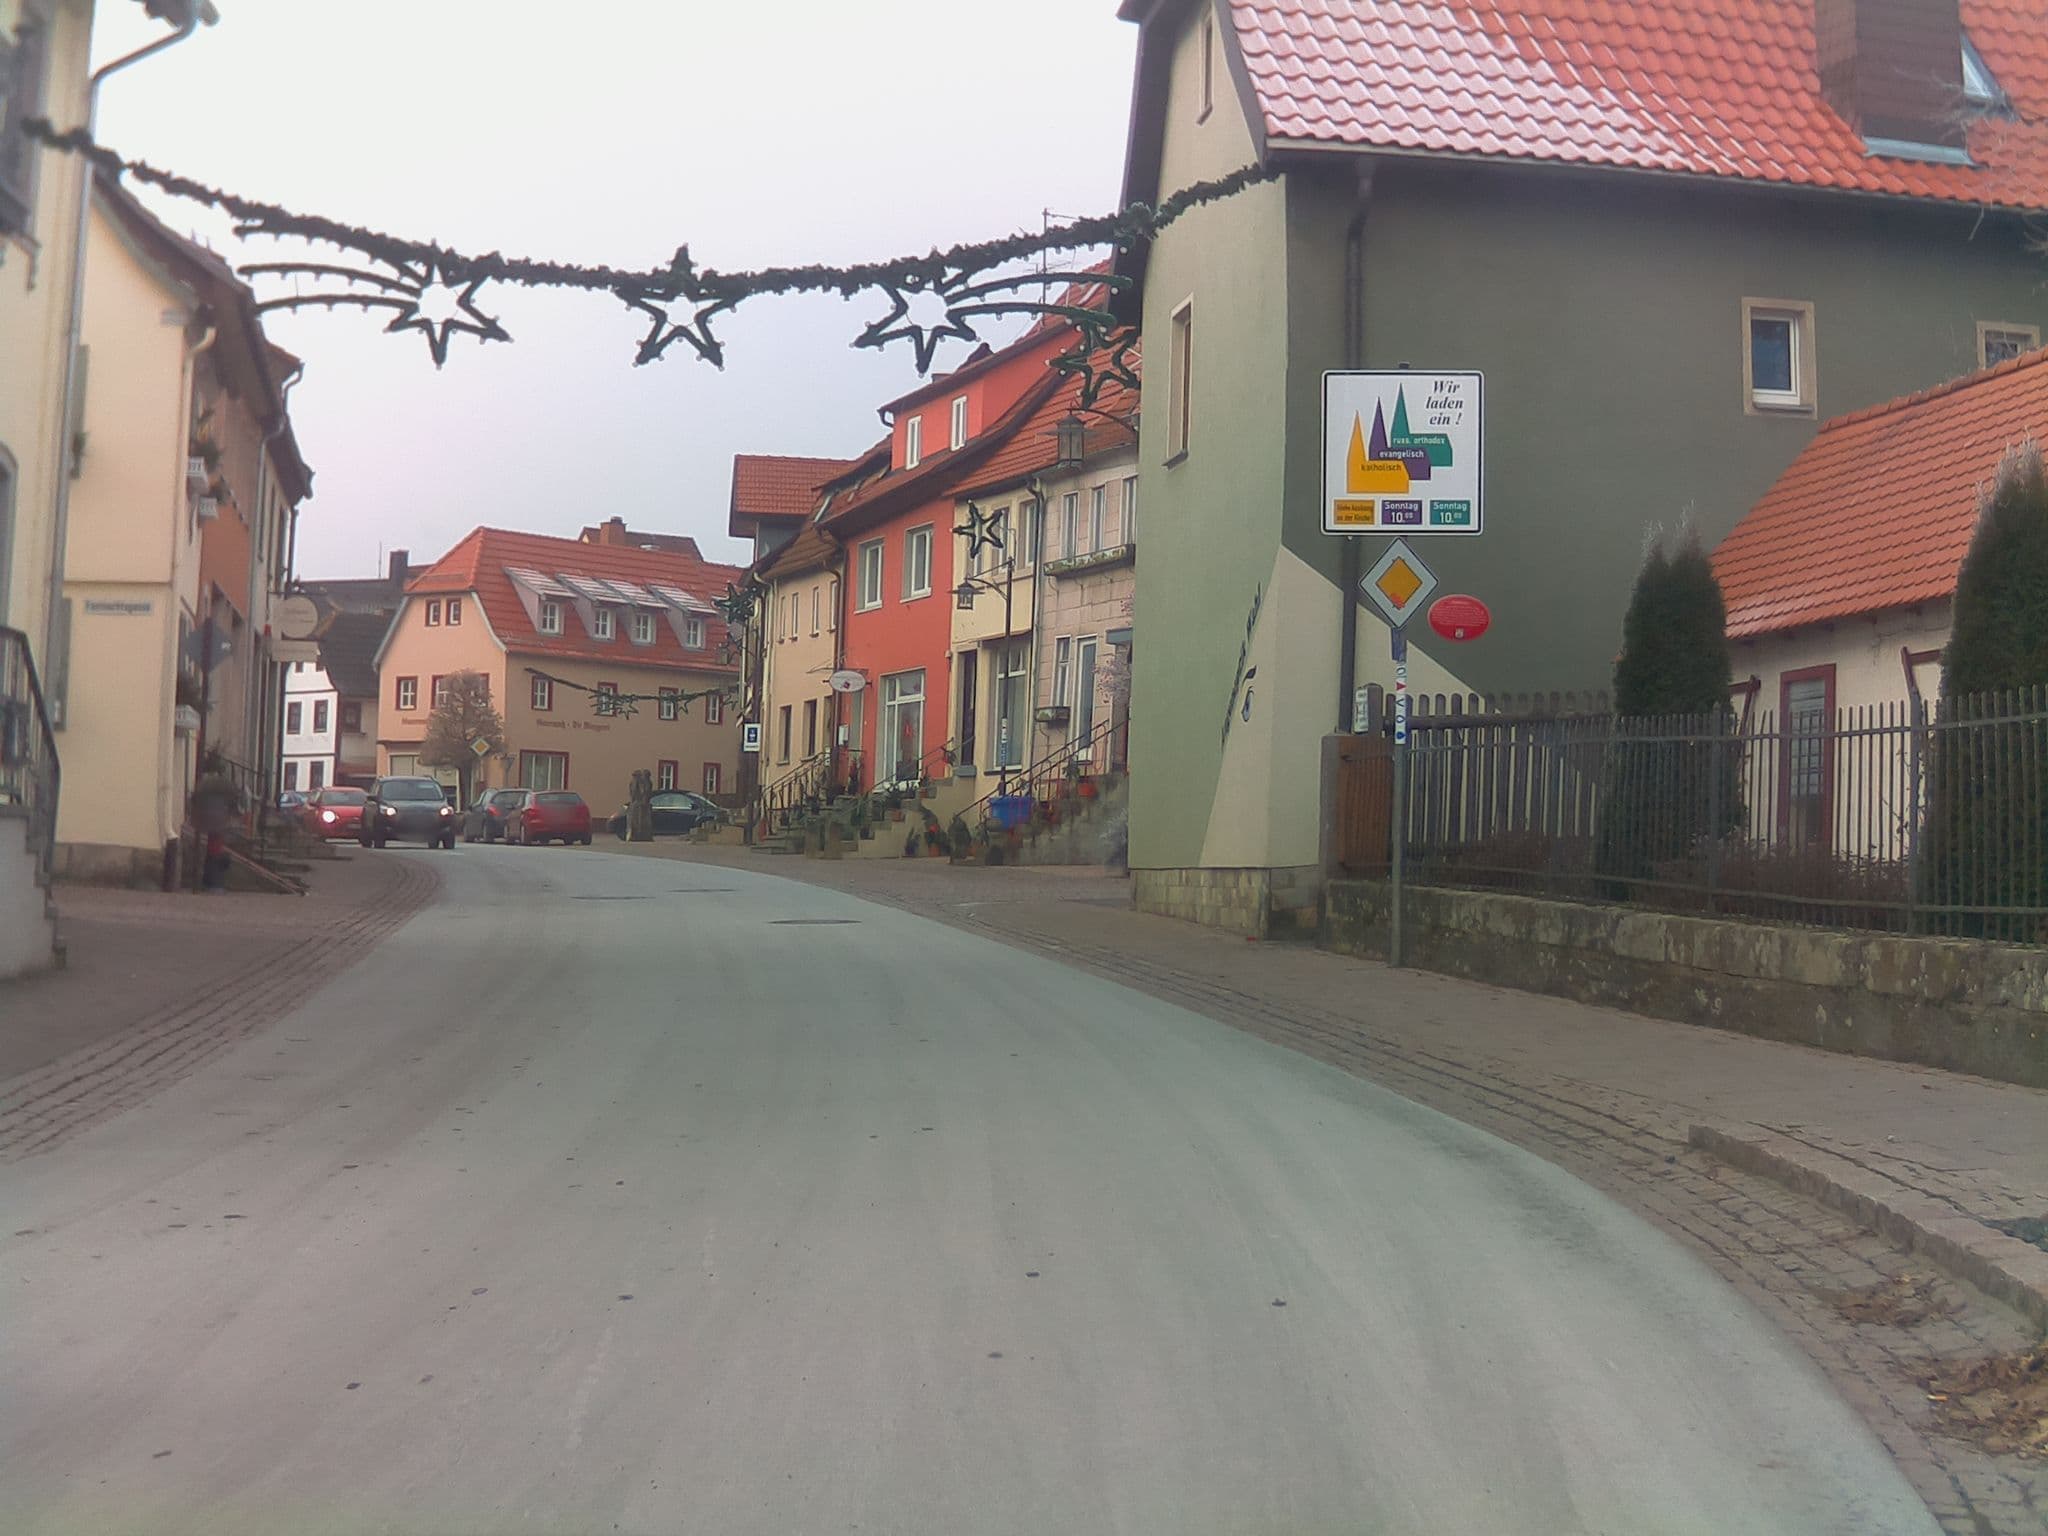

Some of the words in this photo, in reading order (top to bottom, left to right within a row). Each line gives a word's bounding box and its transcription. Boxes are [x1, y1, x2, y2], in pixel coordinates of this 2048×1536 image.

[1433, 380, 1461, 394] Wir
[1425, 396, 1464, 409] laden
[1429, 412, 1450, 426] ein
[1413, 436, 1446, 445] orthodox
[1379, 449, 1425, 460] evangelisch
[1360, 462, 1402, 472] katholisch
[1384, 501, 1419, 512] Sonntag
[1433, 501, 1468, 512] Sonntag
